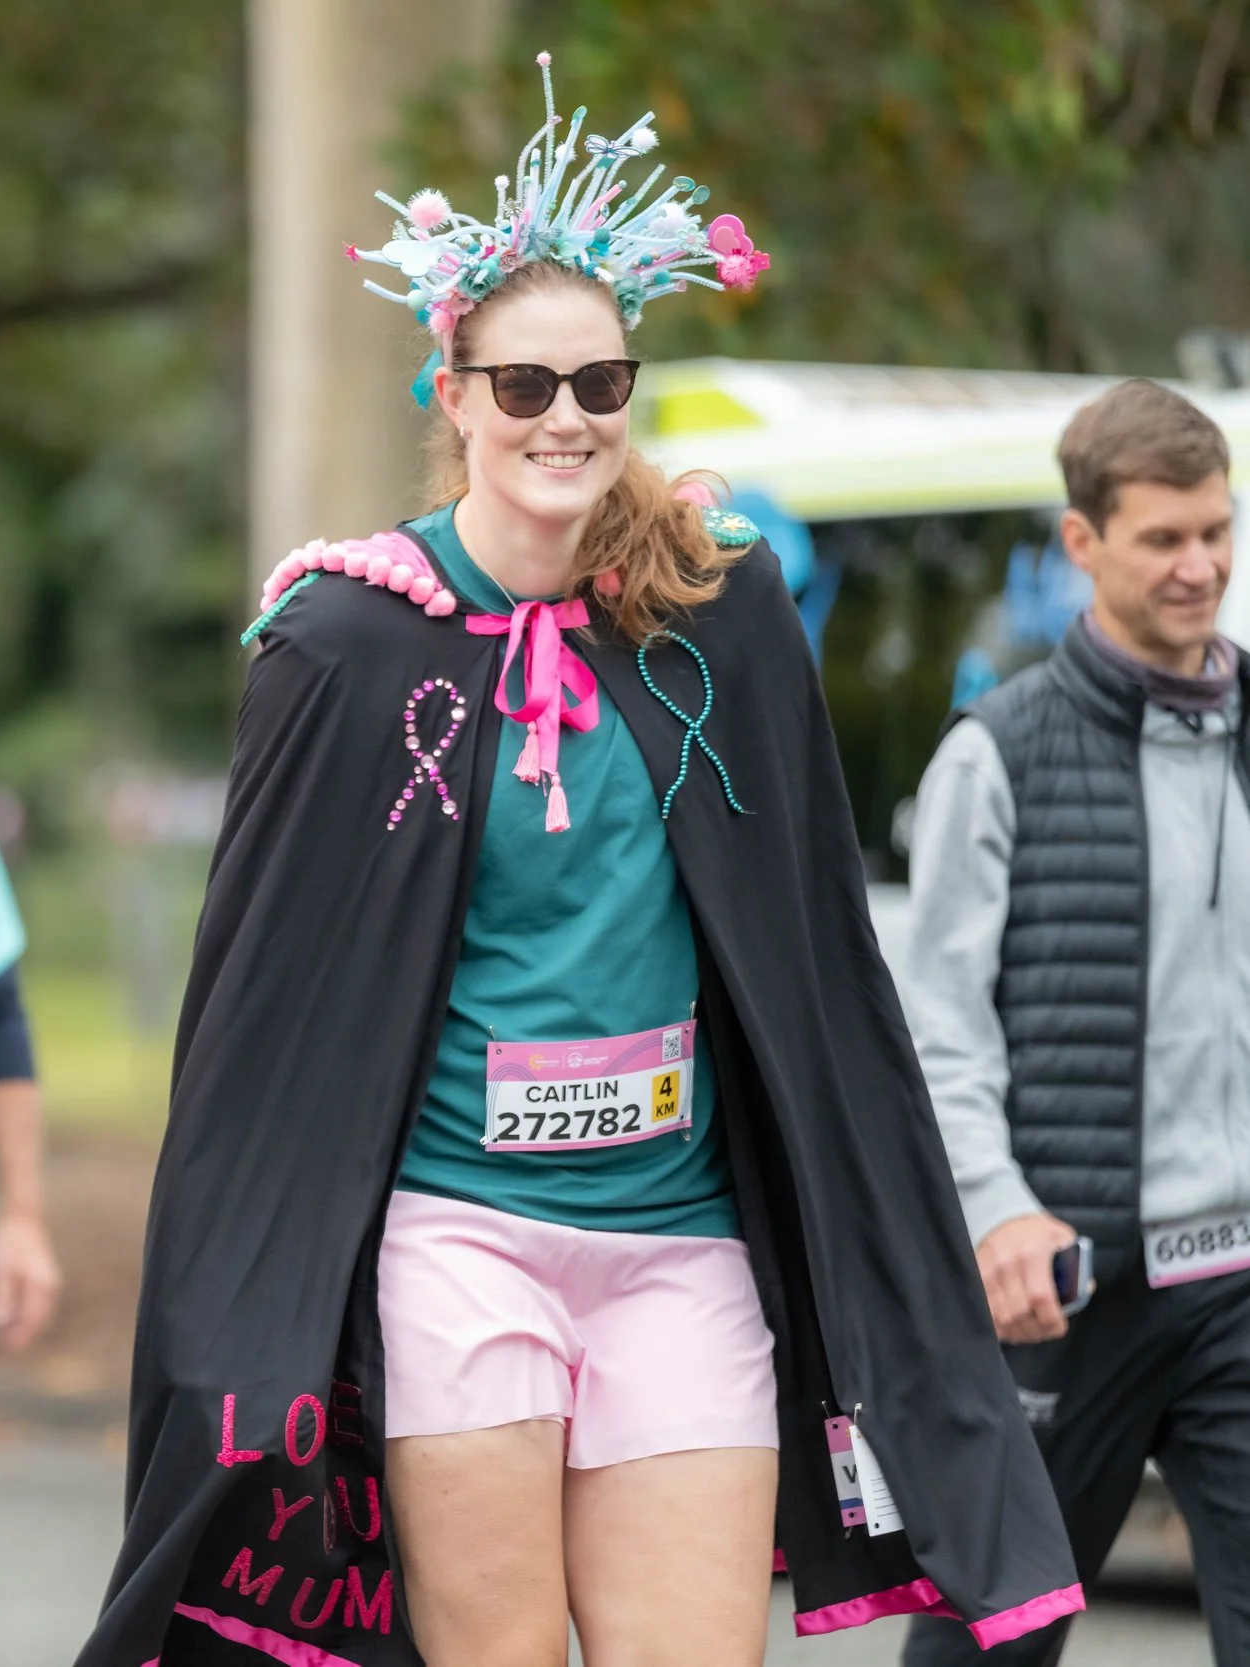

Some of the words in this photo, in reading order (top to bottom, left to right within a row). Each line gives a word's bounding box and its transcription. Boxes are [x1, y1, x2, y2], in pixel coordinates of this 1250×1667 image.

[525, 1080, 619, 1104] CAITLIN
[659, 1075, 673, 1098] 4
[656, 1101, 675, 1118] KM
[497, 1103, 641, 1141] 272782
[221, 1546, 393, 1636] MUM
